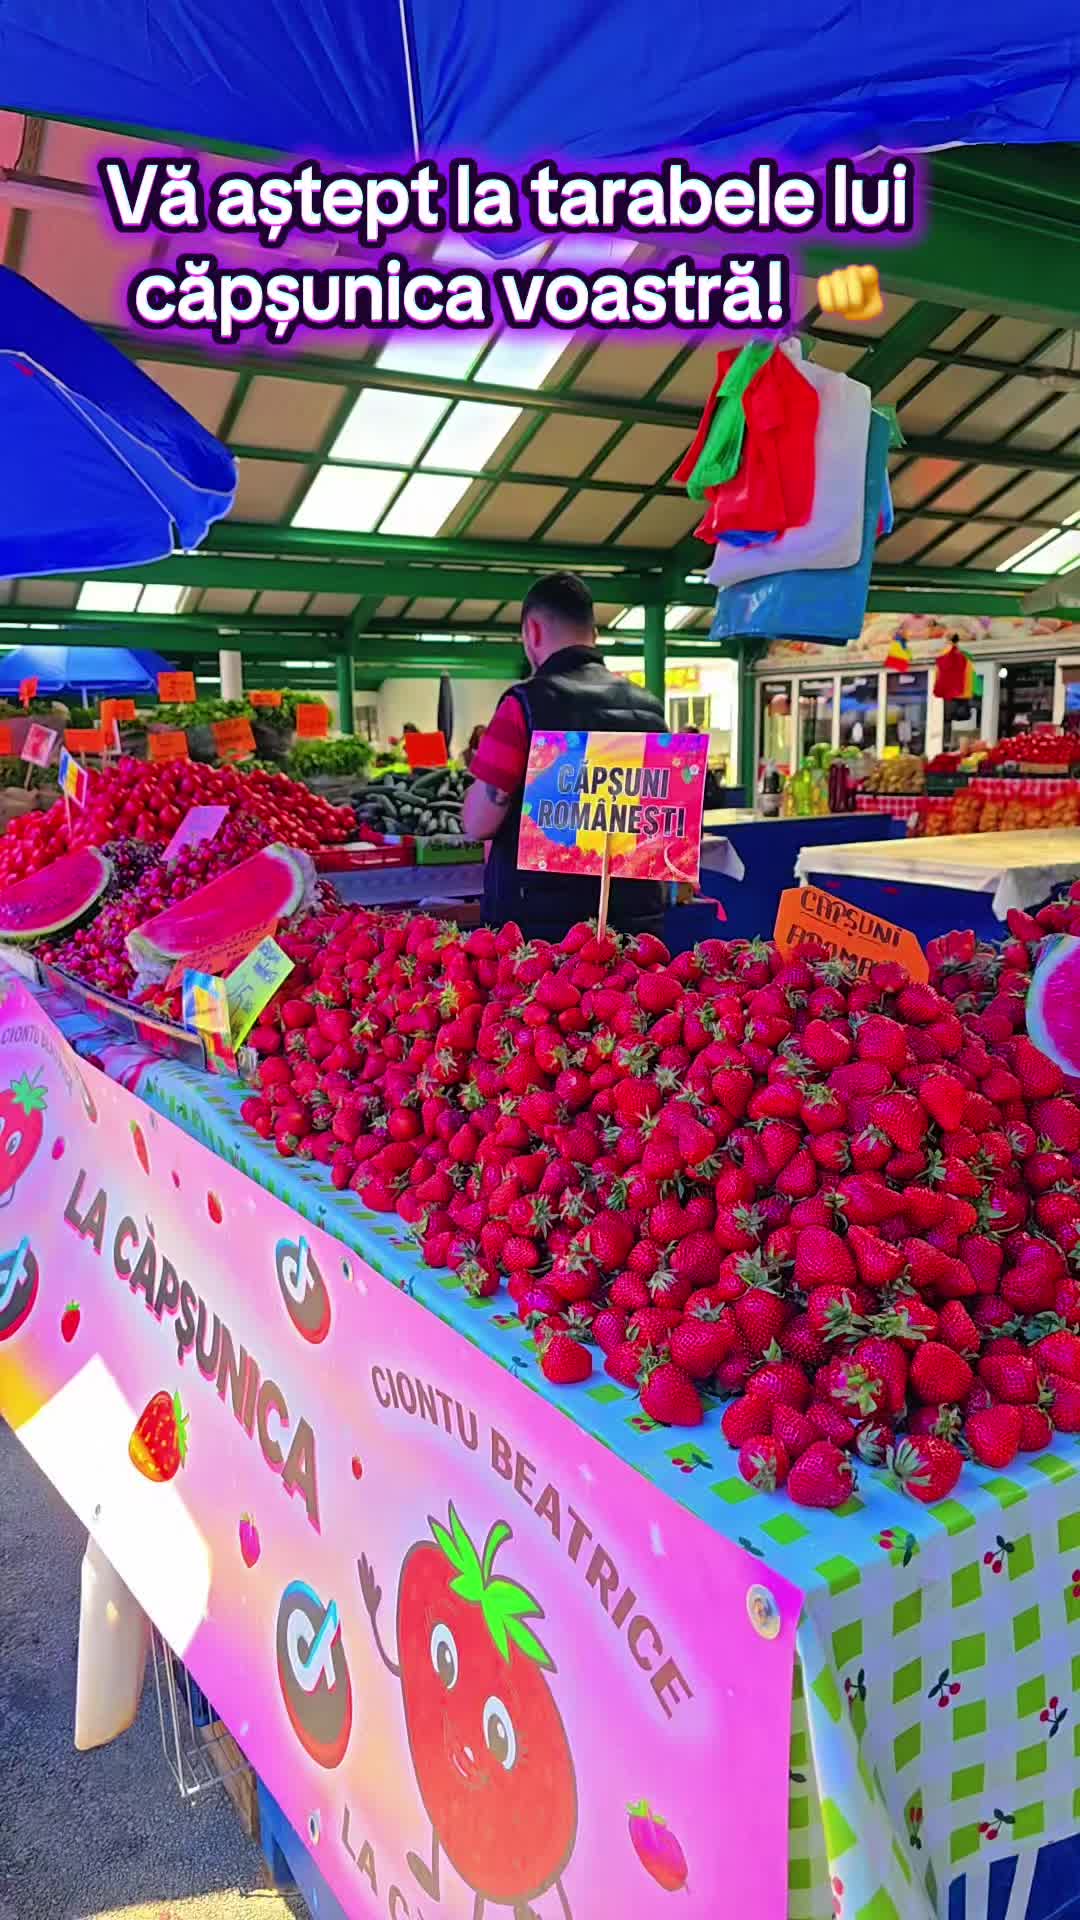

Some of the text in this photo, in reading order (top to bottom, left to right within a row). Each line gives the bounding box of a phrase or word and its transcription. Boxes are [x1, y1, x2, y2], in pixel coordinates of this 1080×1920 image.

[537, 798, 686, 840] ROMÂNEȘTI
[64, 1168, 107, 1255] LA
[372, 1365, 696, 1720] CIONTU BEATRICE
[342, 1802, 378, 1896] LA
